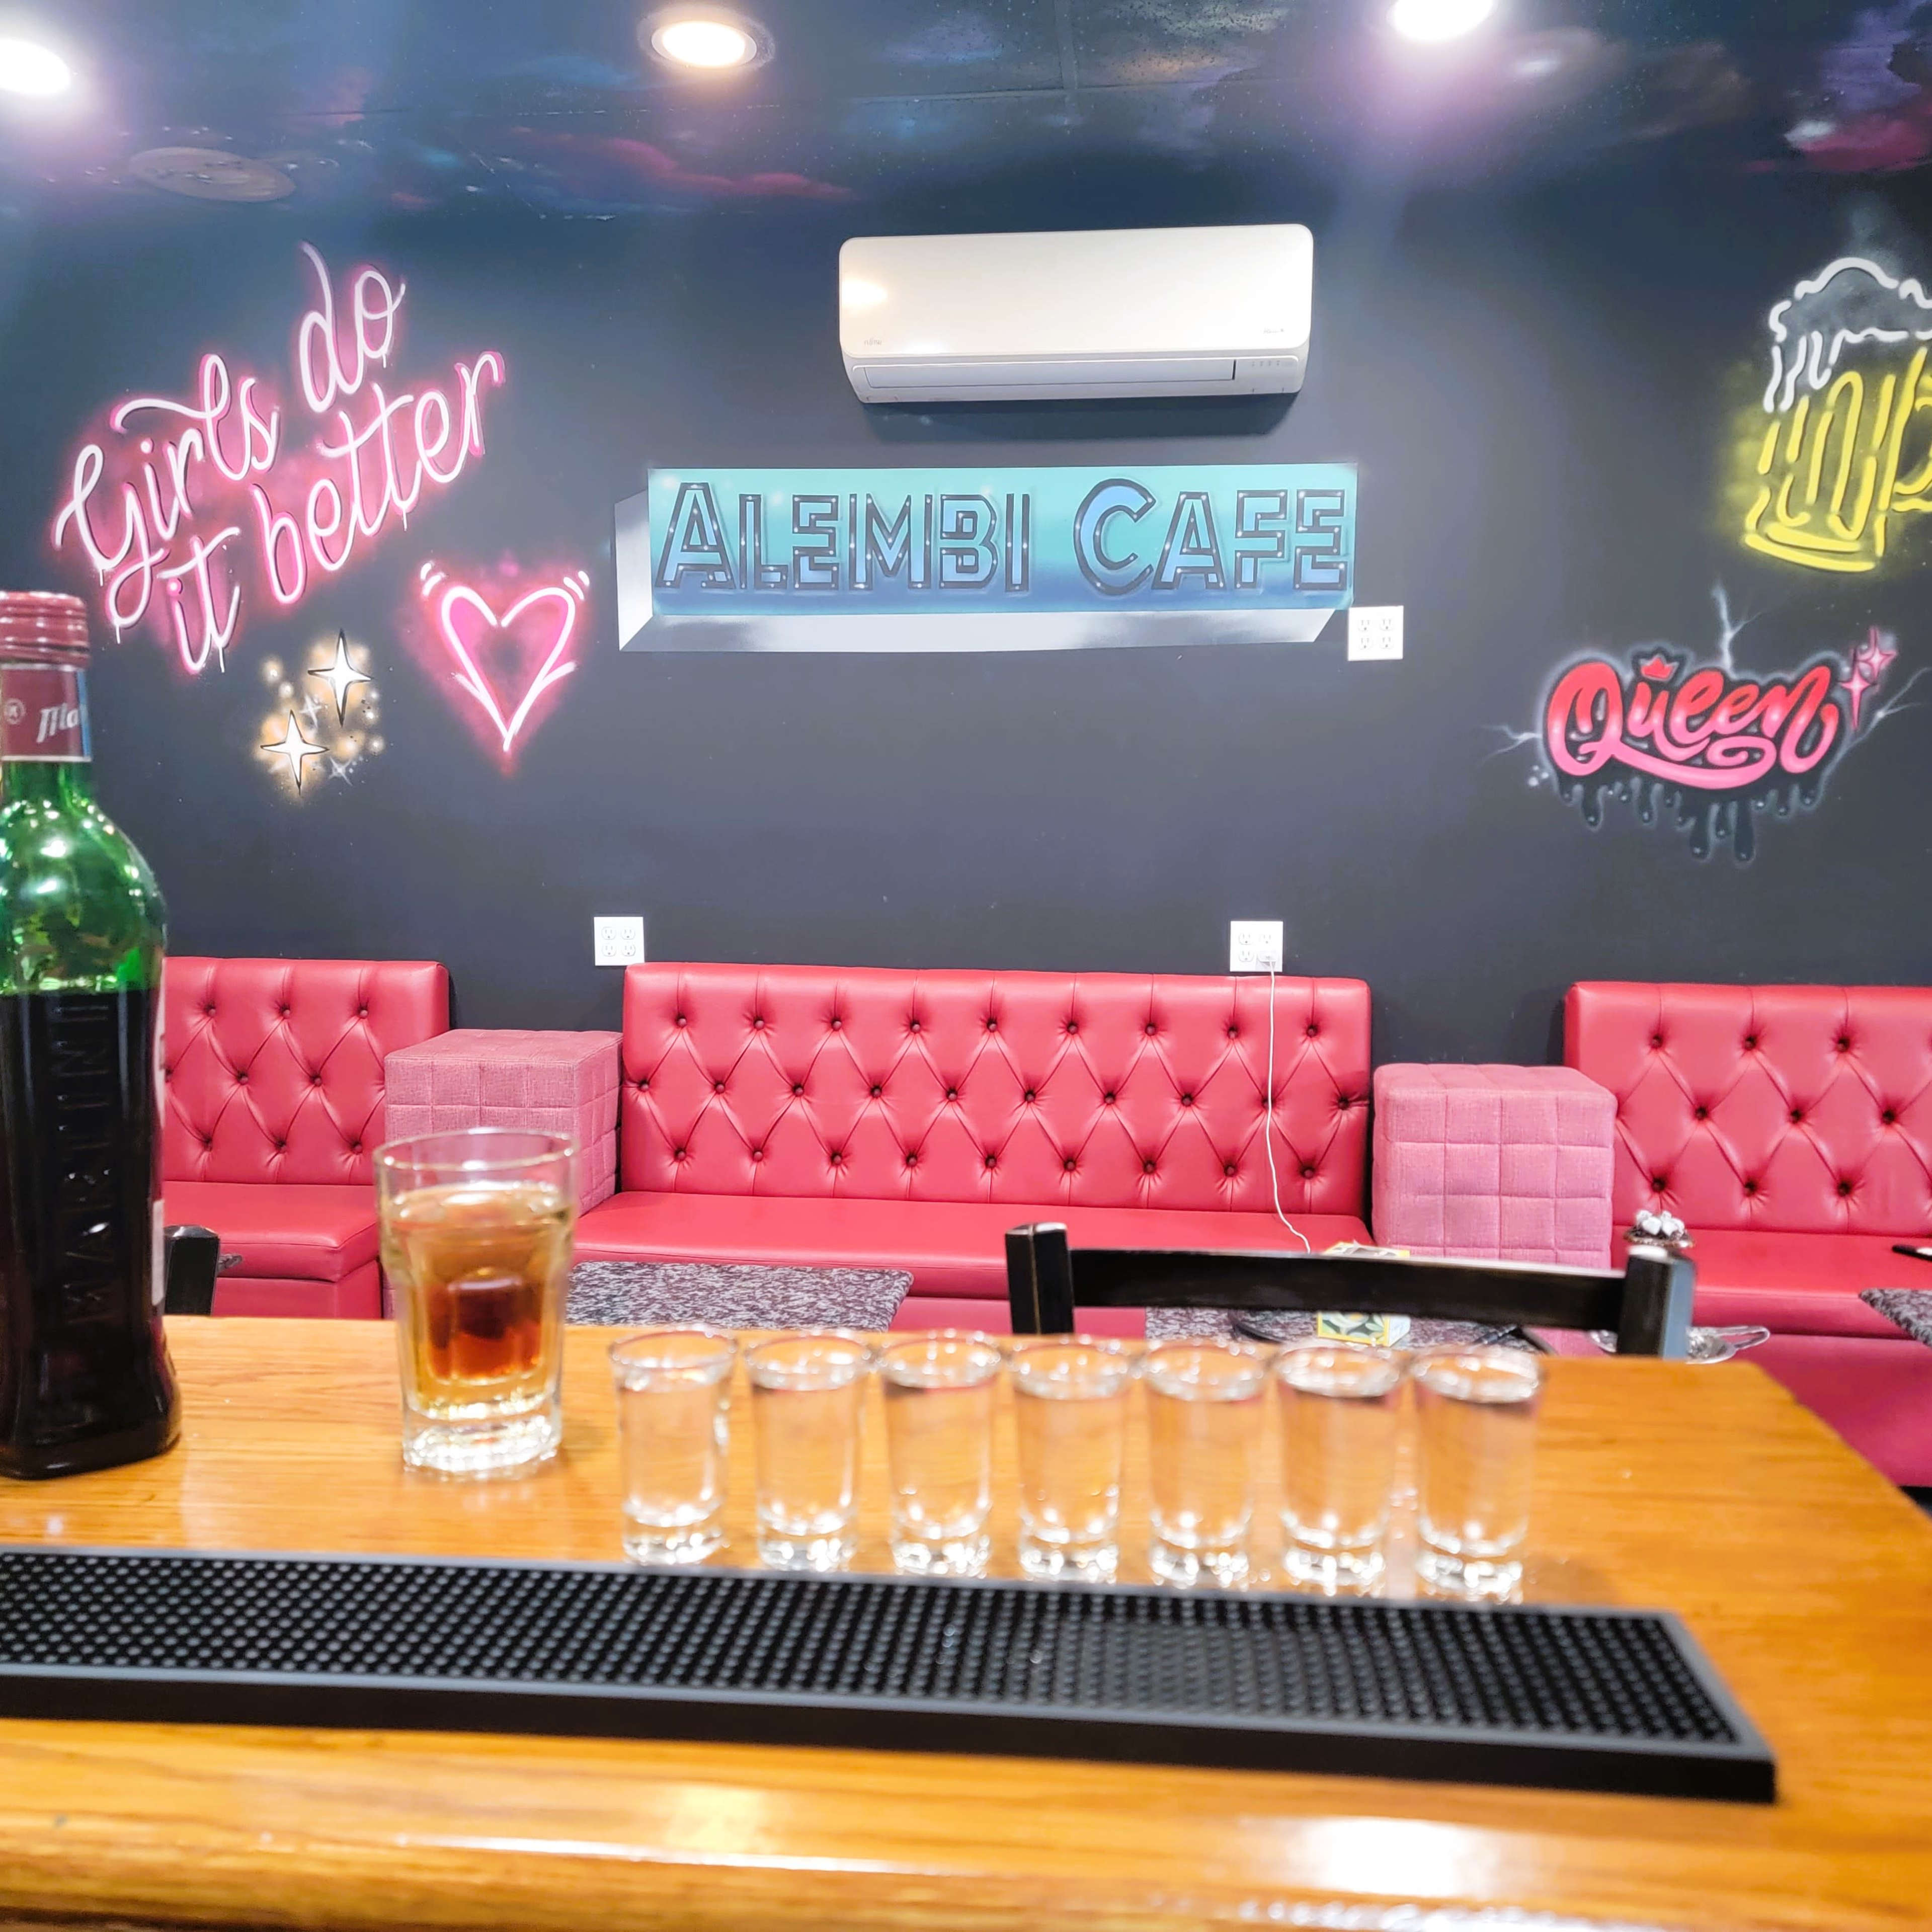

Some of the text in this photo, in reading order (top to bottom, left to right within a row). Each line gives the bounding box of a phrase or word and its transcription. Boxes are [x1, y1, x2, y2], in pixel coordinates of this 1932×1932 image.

[54, 240, 406, 629] Girls do
[156, 351, 505, 674] it better
[654, 478, 1350, 596] ALEMBI CAFE
[1547, 661, 1840, 790] Queen
